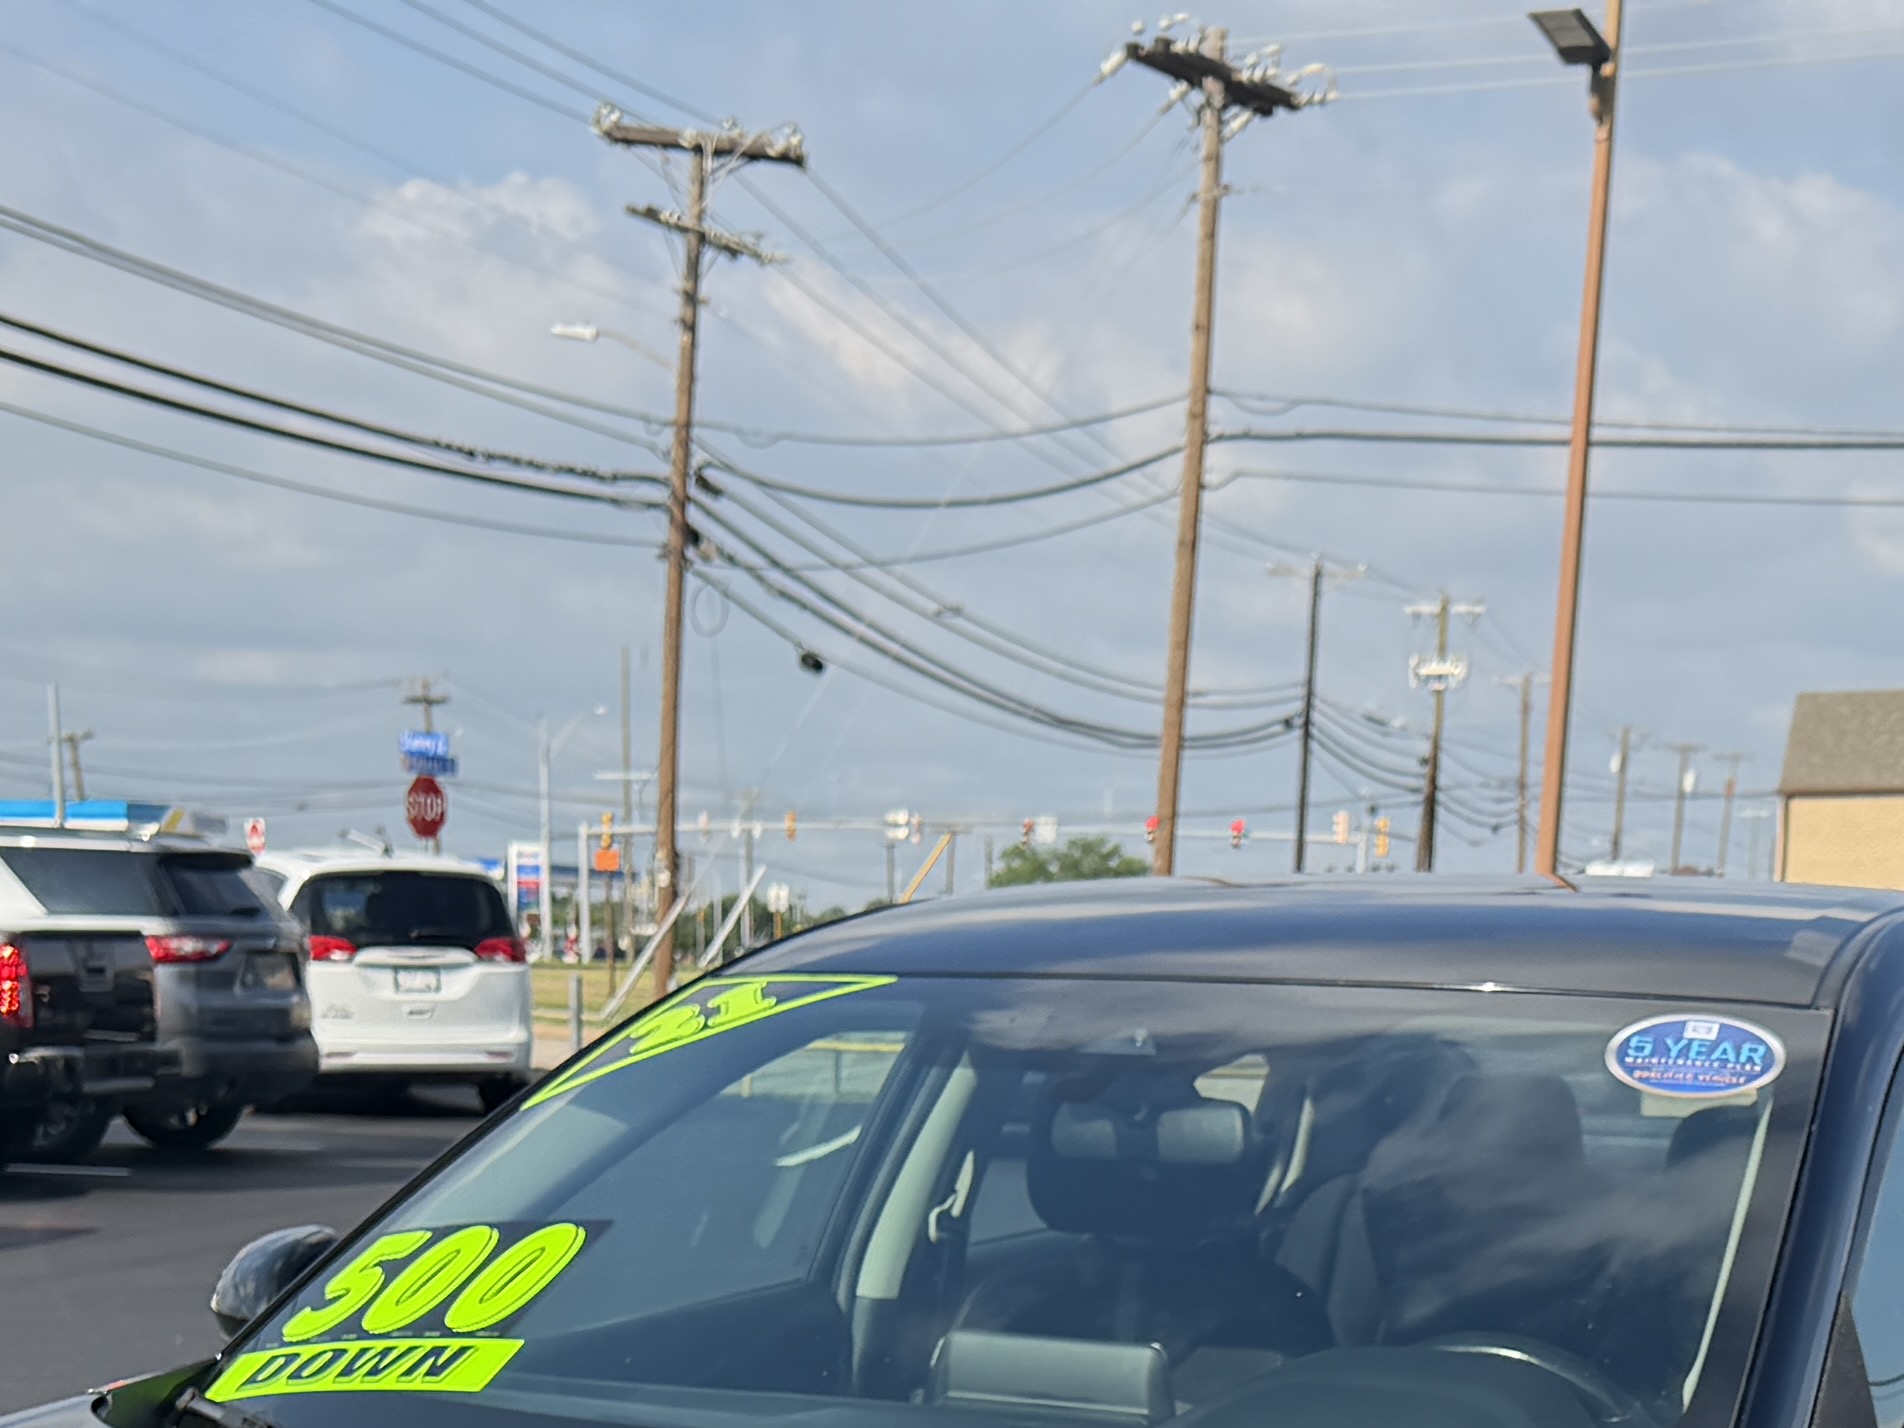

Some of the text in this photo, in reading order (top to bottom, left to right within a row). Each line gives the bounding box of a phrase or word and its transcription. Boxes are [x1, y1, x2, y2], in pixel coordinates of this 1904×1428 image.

[407, 794, 444, 822] STOP
[629, 980, 777, 1055] 21
[1626, 1034, 1768, 1065] 5 YEAR
[282, 1223, 587, 1342] 500
[236, 1346, 479, 1391] DOWN
